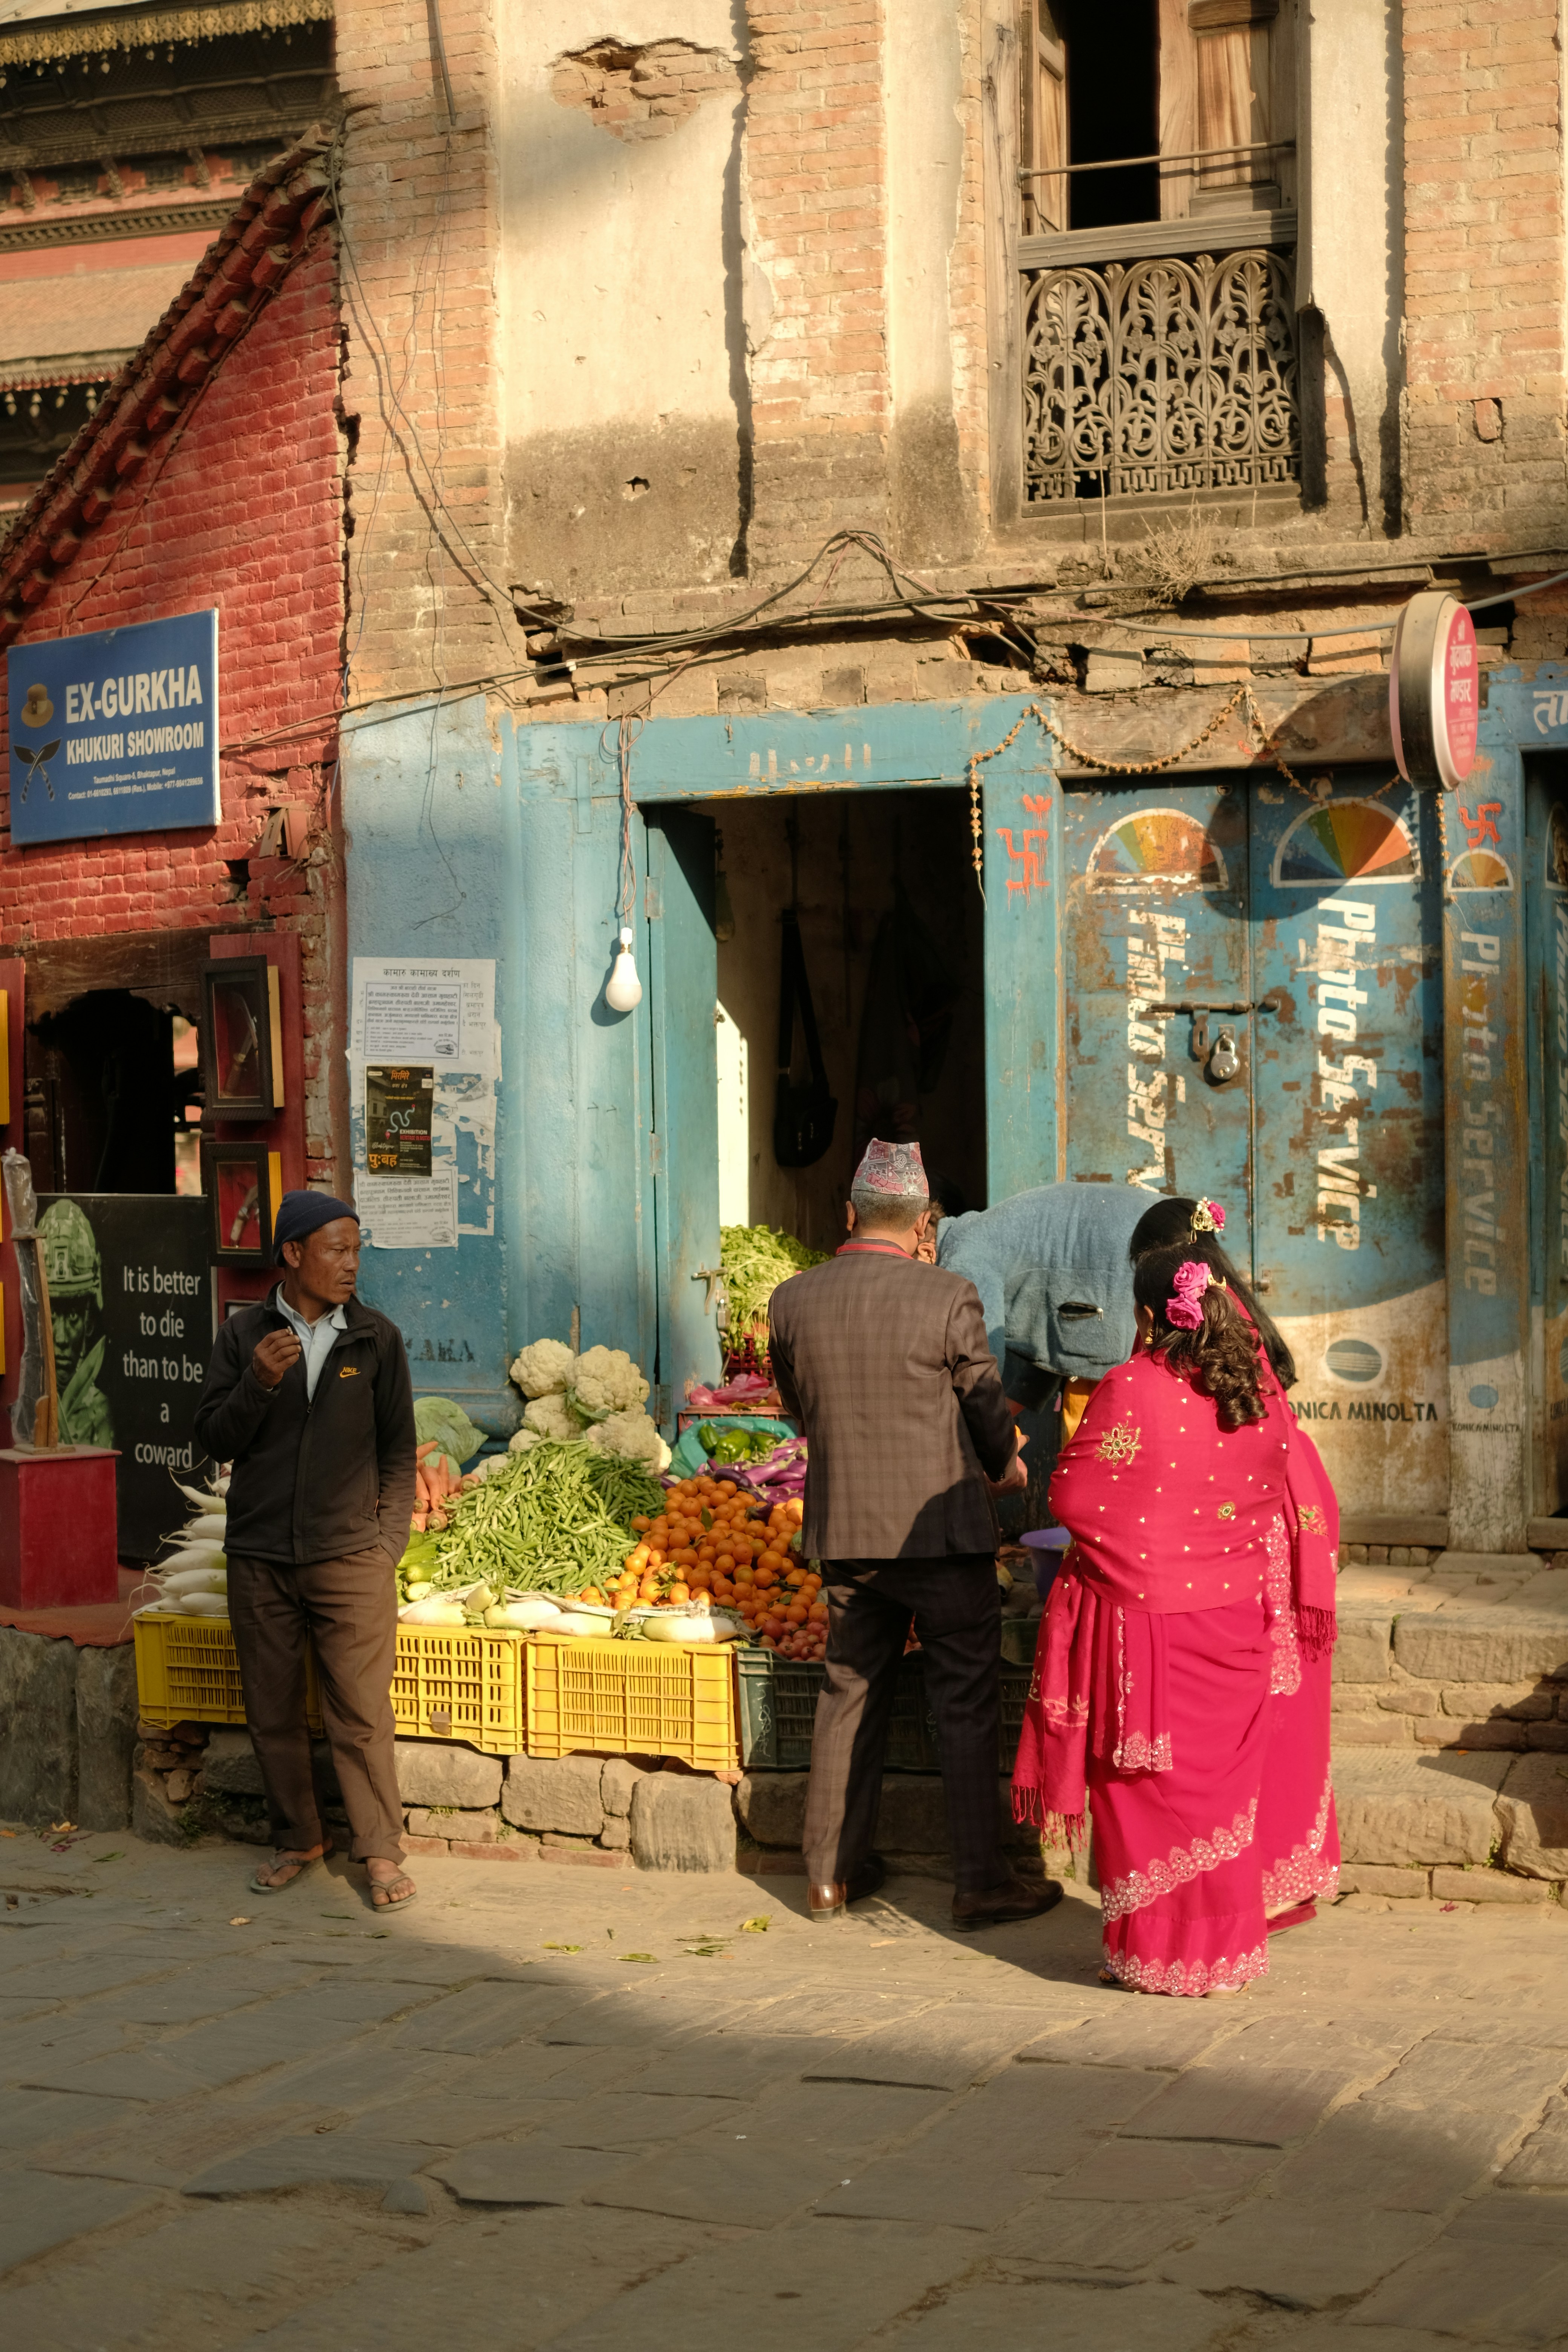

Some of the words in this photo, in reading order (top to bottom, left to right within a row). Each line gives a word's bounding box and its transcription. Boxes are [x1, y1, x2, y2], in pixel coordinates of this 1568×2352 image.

[66, 664, 203, 724] EX-GURKHA
[66, 733, 124, 765] KHUKURI
[127, 721, 204, 758] SHOWROOM
[162, 766, 176, 776] Nepal
[390, 1070, 410, 1081] मिरमिरे
[1127, 1062, 1186, 1194] Serv
[123, 1265, 135, 1293] It
[138, 1266, 150, 1293] is
[153, 1265, 201, 1295] better
[139, 1311, 156, 1336] to
[159, 1309, 184, 1338] die
[122, 1349, 158, 1379] than
[162, 1357, 179, 1381] to
[183, 1354, 203, 1383] be
[160, 1402, 170, 1423] a
[1288, 1401, 1342, 1420] NICA
[1347, 1402, 1438, 1422] MINOLTA
[135, 1441, 193, 1469] coward
